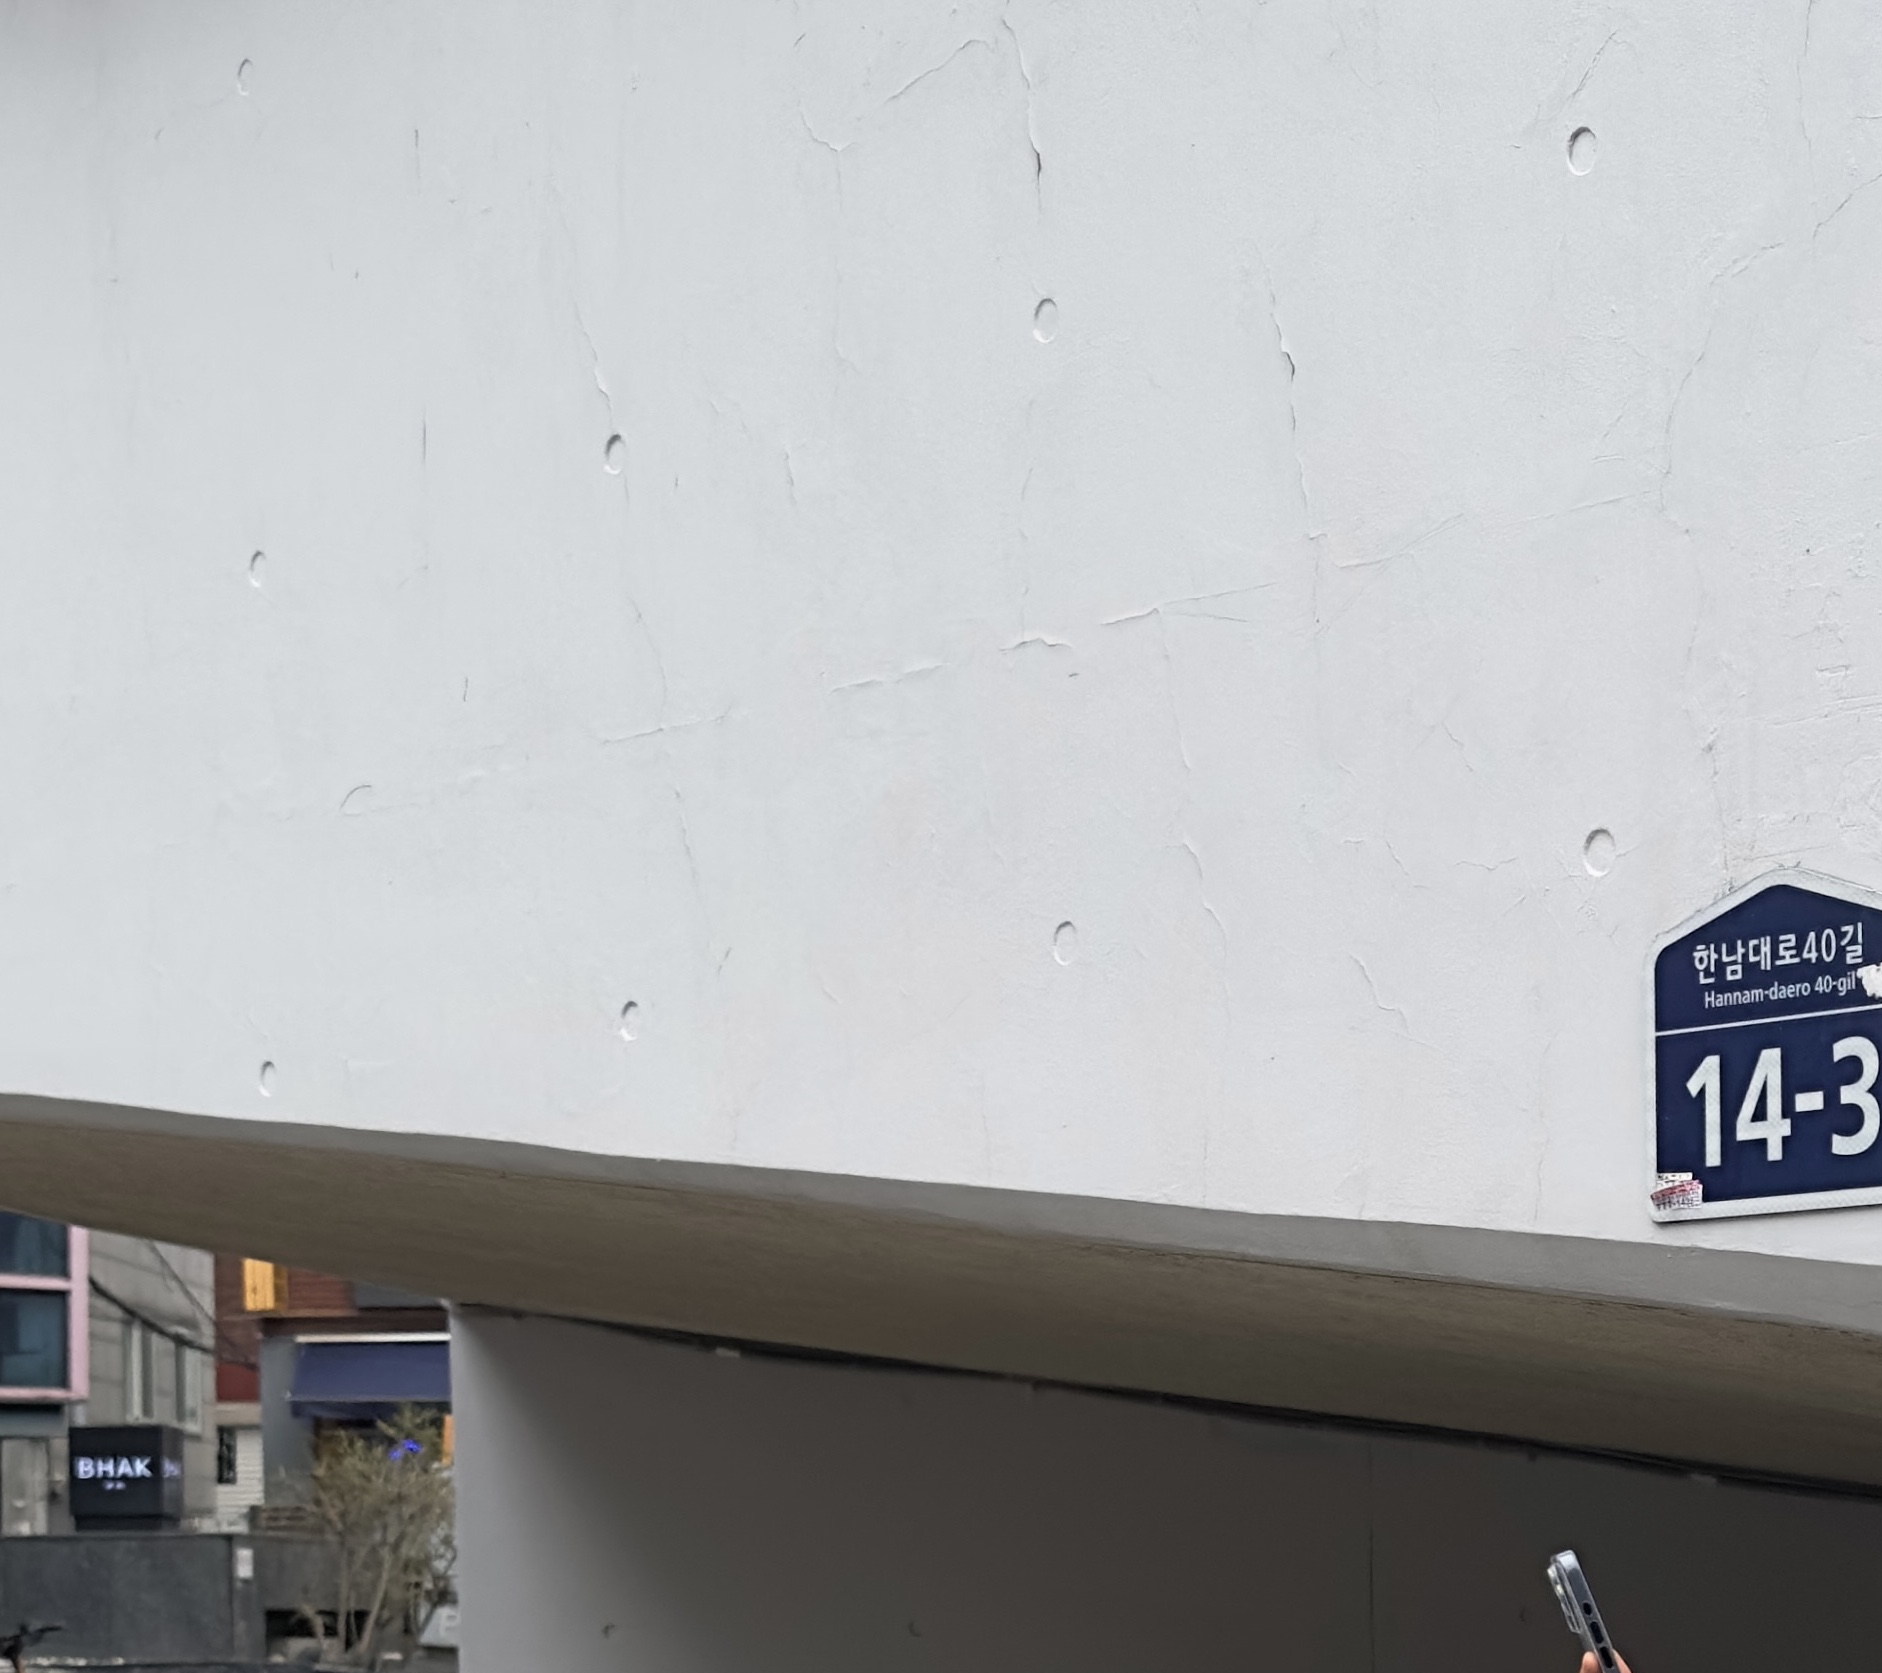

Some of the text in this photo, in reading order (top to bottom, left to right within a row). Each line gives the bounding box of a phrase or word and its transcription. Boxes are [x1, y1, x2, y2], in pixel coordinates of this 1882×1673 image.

[1692, 921, 1864, 985] 한남대로40길
[1704, 971, 1857, 1009] Hannam-daero 40-gil
[1685, 1035, 1881, 1168] 14-3
[77, 1456, 153, 1479] BHAK
